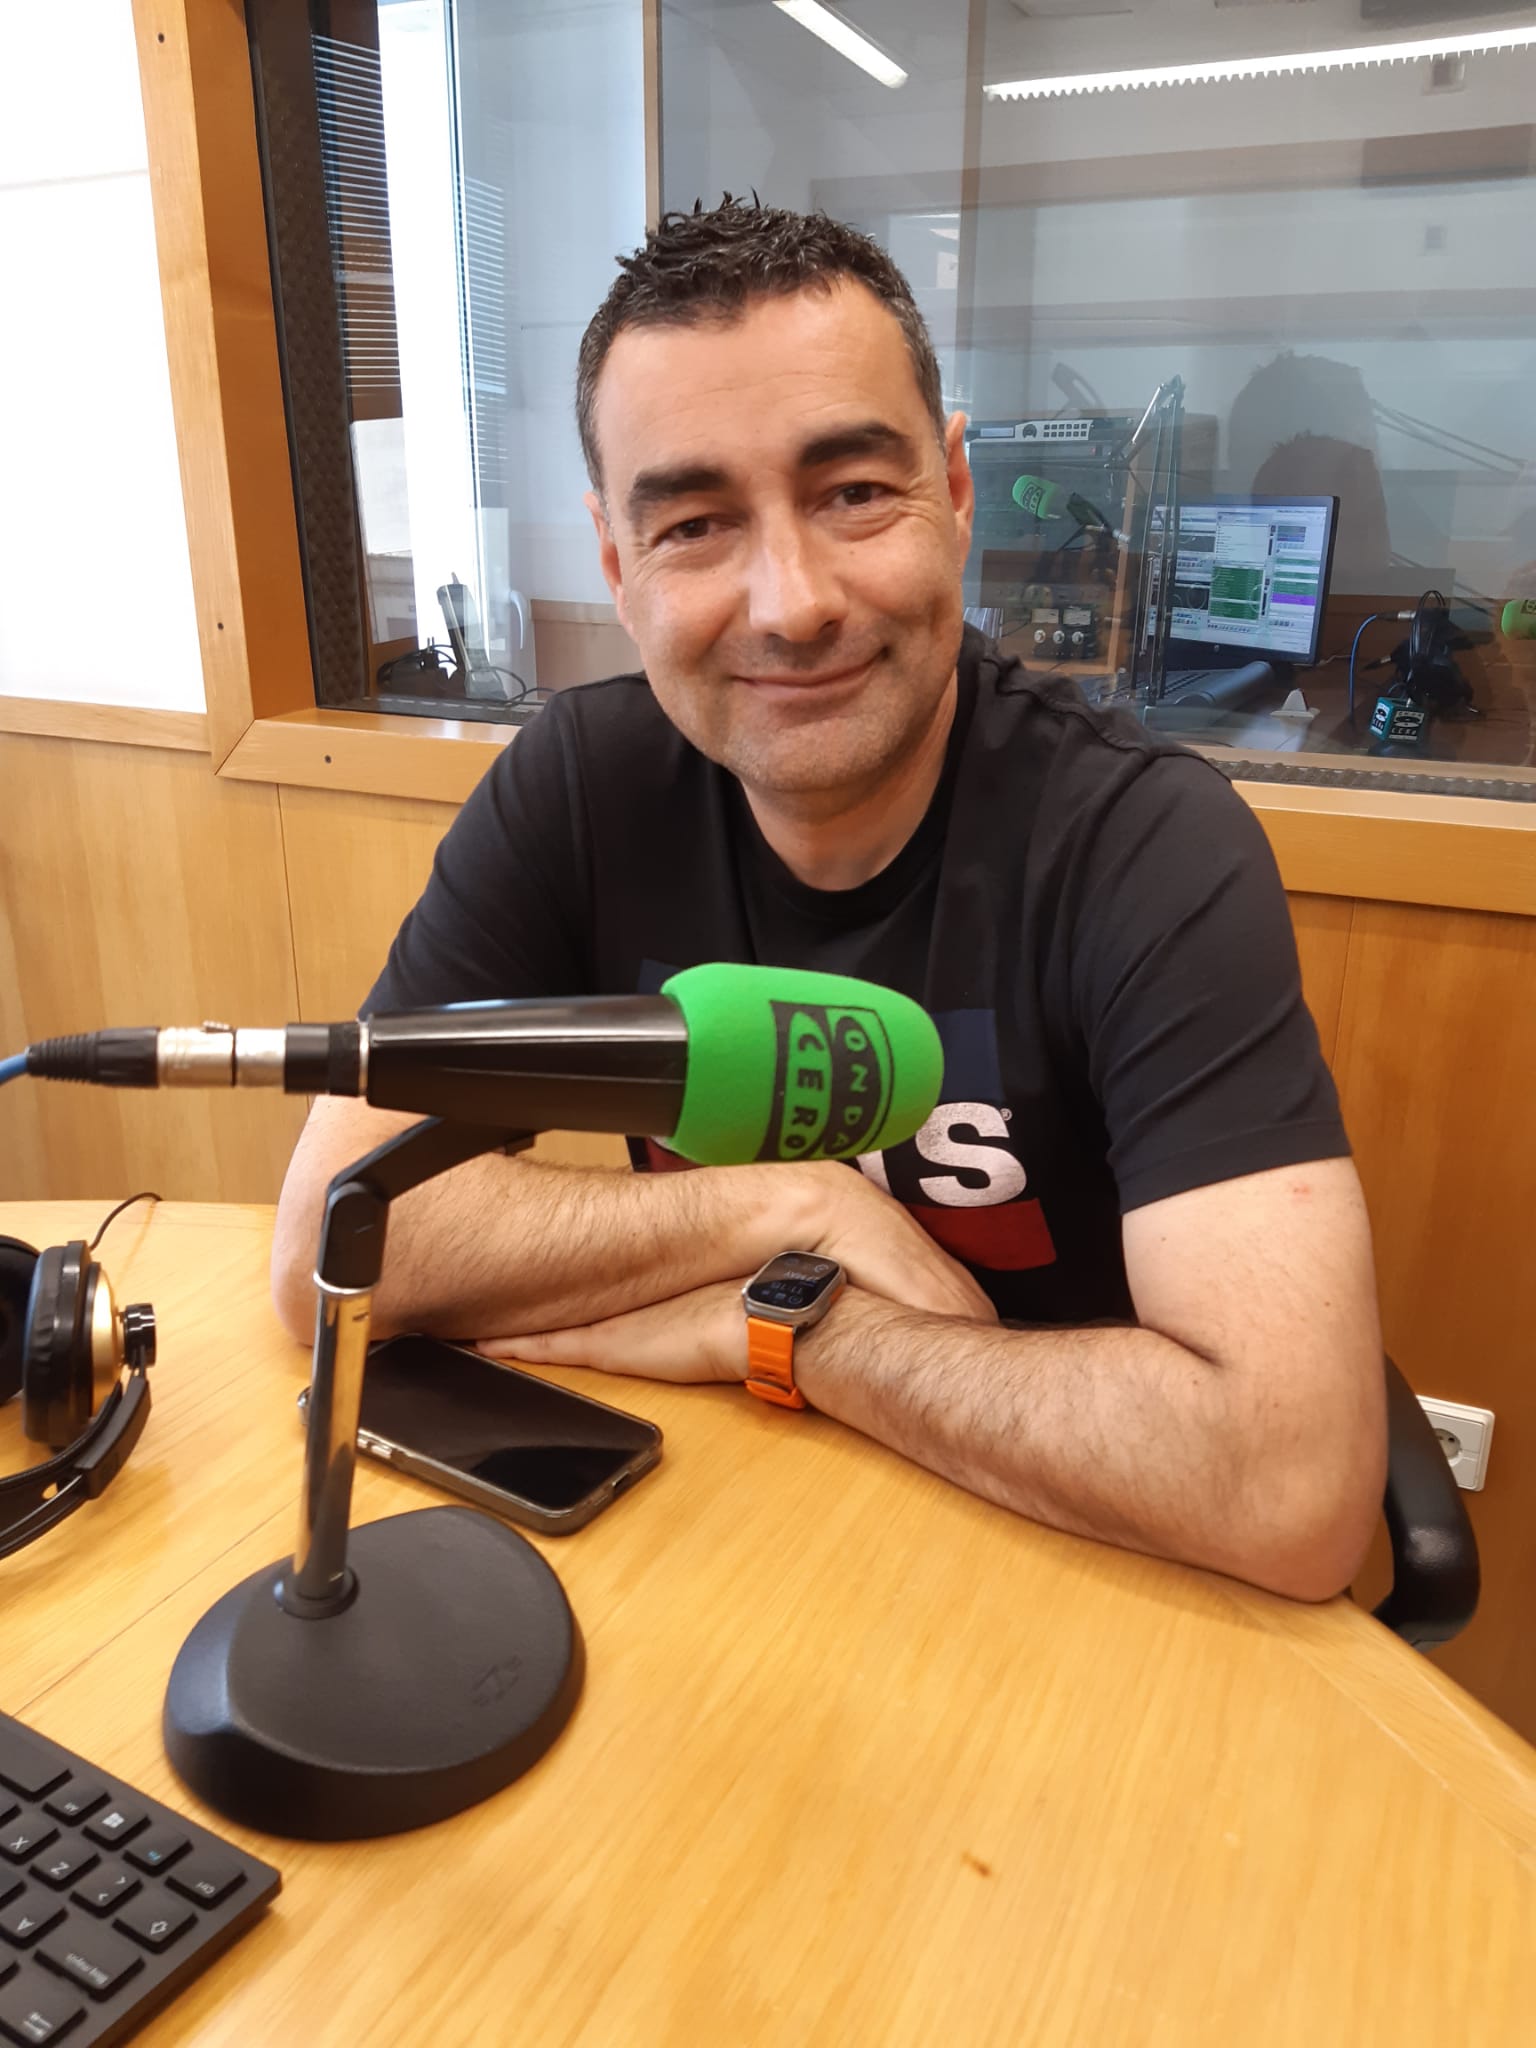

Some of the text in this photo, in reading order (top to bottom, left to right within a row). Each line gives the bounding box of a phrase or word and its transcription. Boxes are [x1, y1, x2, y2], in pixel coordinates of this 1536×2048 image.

[785, 1033, 824, 1149] CERO
[832, 1028, 868, 1147] ONDA
[9, 1836, 29, 1850] X
[50, 1861, 70, 1875] Z
[195, 1881, 215, 1895] Ctrl
[17, 1917, 35, 1931] A
